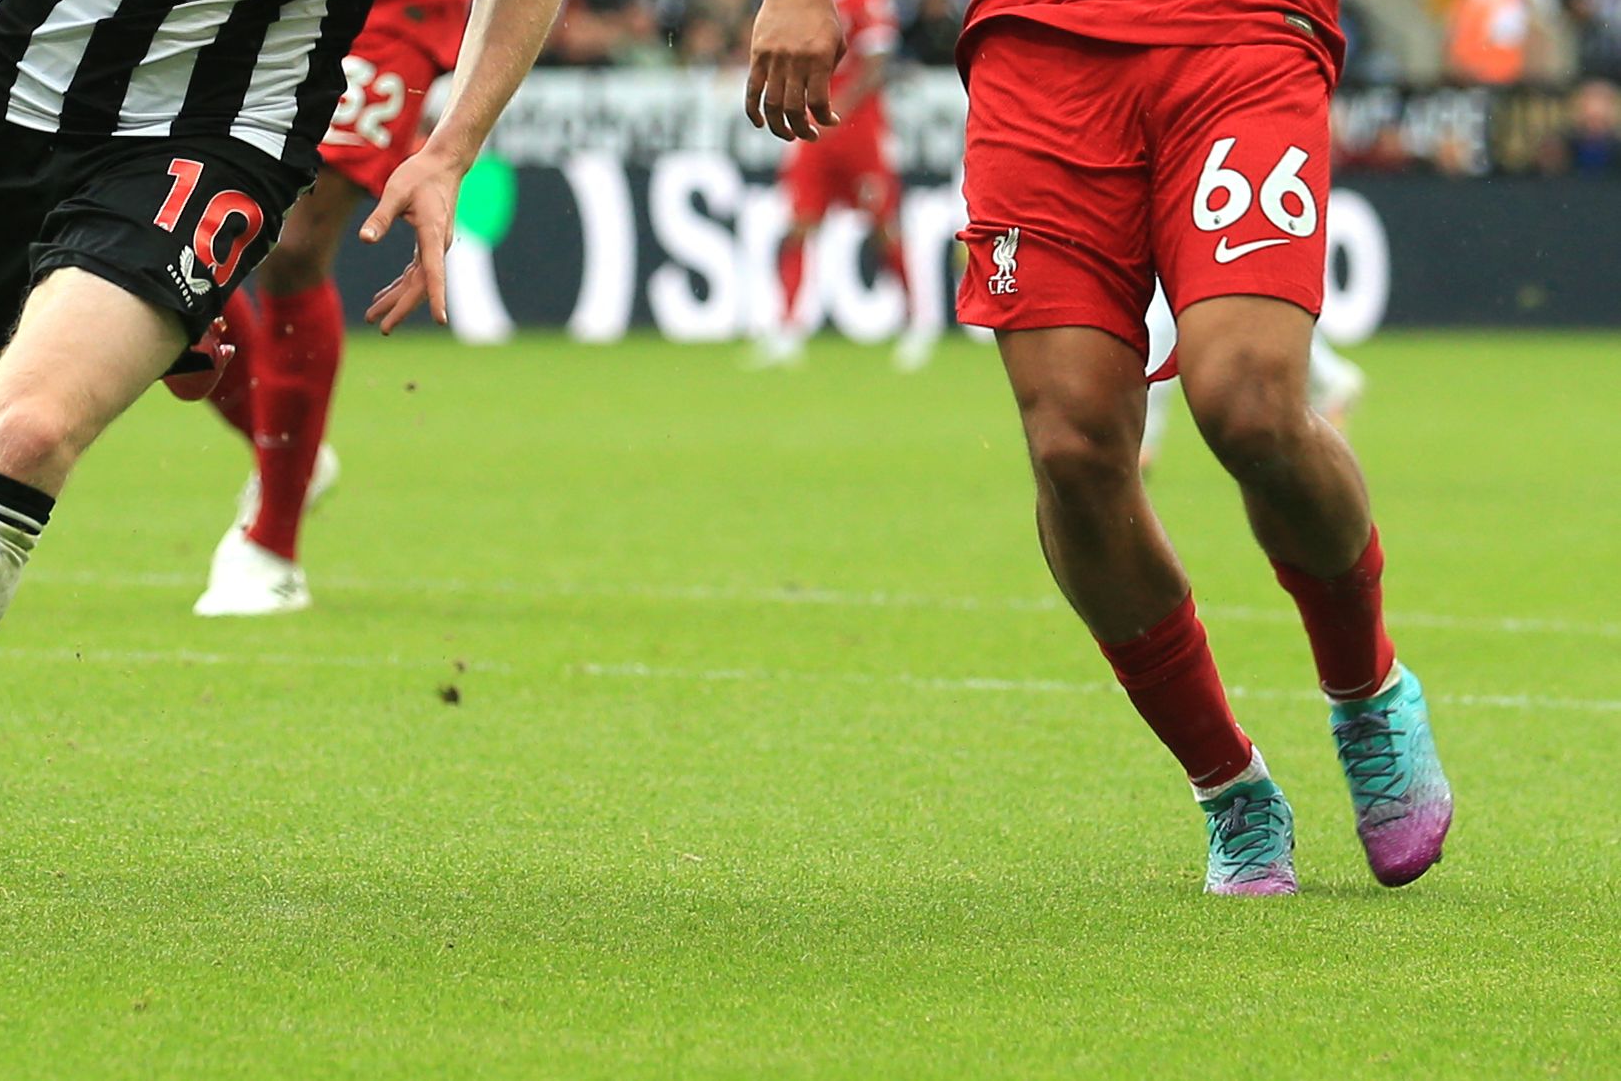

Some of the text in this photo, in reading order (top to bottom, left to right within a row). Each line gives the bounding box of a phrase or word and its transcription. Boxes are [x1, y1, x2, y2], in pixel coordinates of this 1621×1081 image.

[329, 55, 406, 150] 32
[153, 157, 265, 288] 10
[1192, 137, 1319, 238] 66
